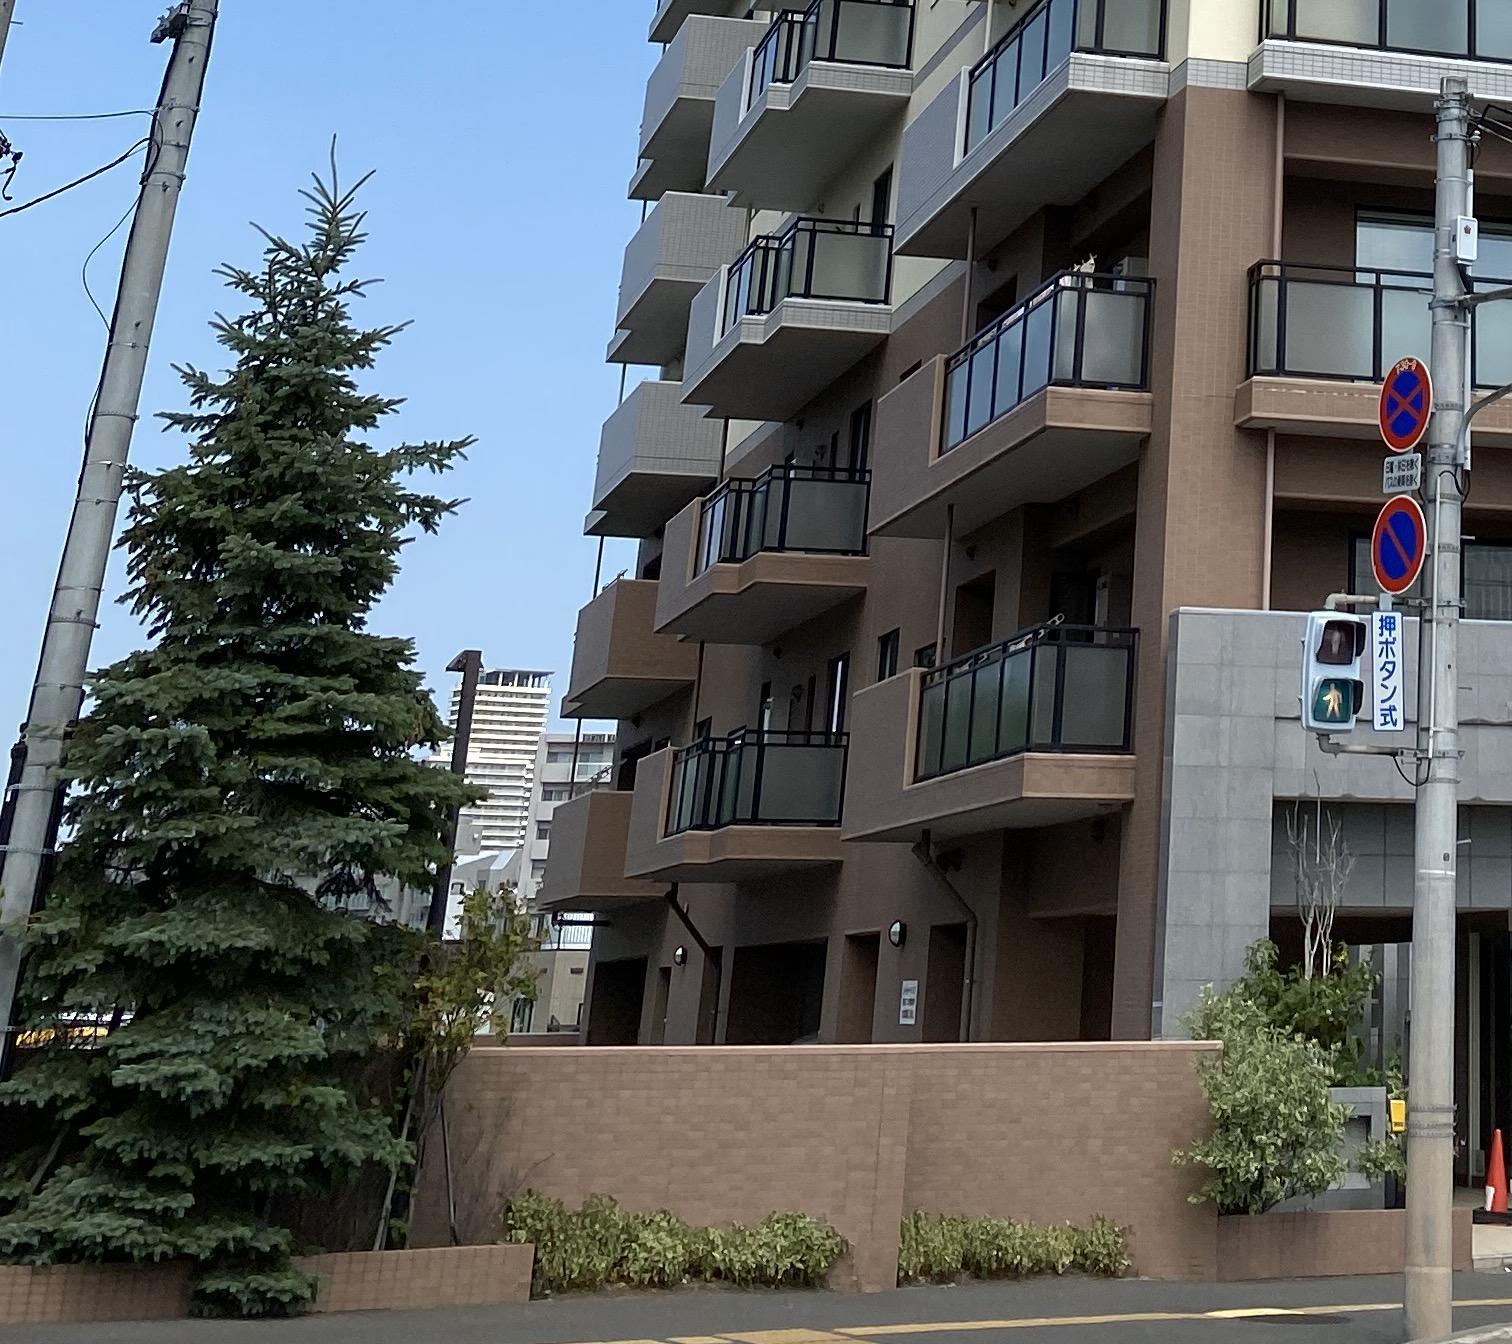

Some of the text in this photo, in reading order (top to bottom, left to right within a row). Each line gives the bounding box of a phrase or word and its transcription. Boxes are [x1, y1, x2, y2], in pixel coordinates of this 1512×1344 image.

[1378, 615, 1397, 727] 押ボタン式
